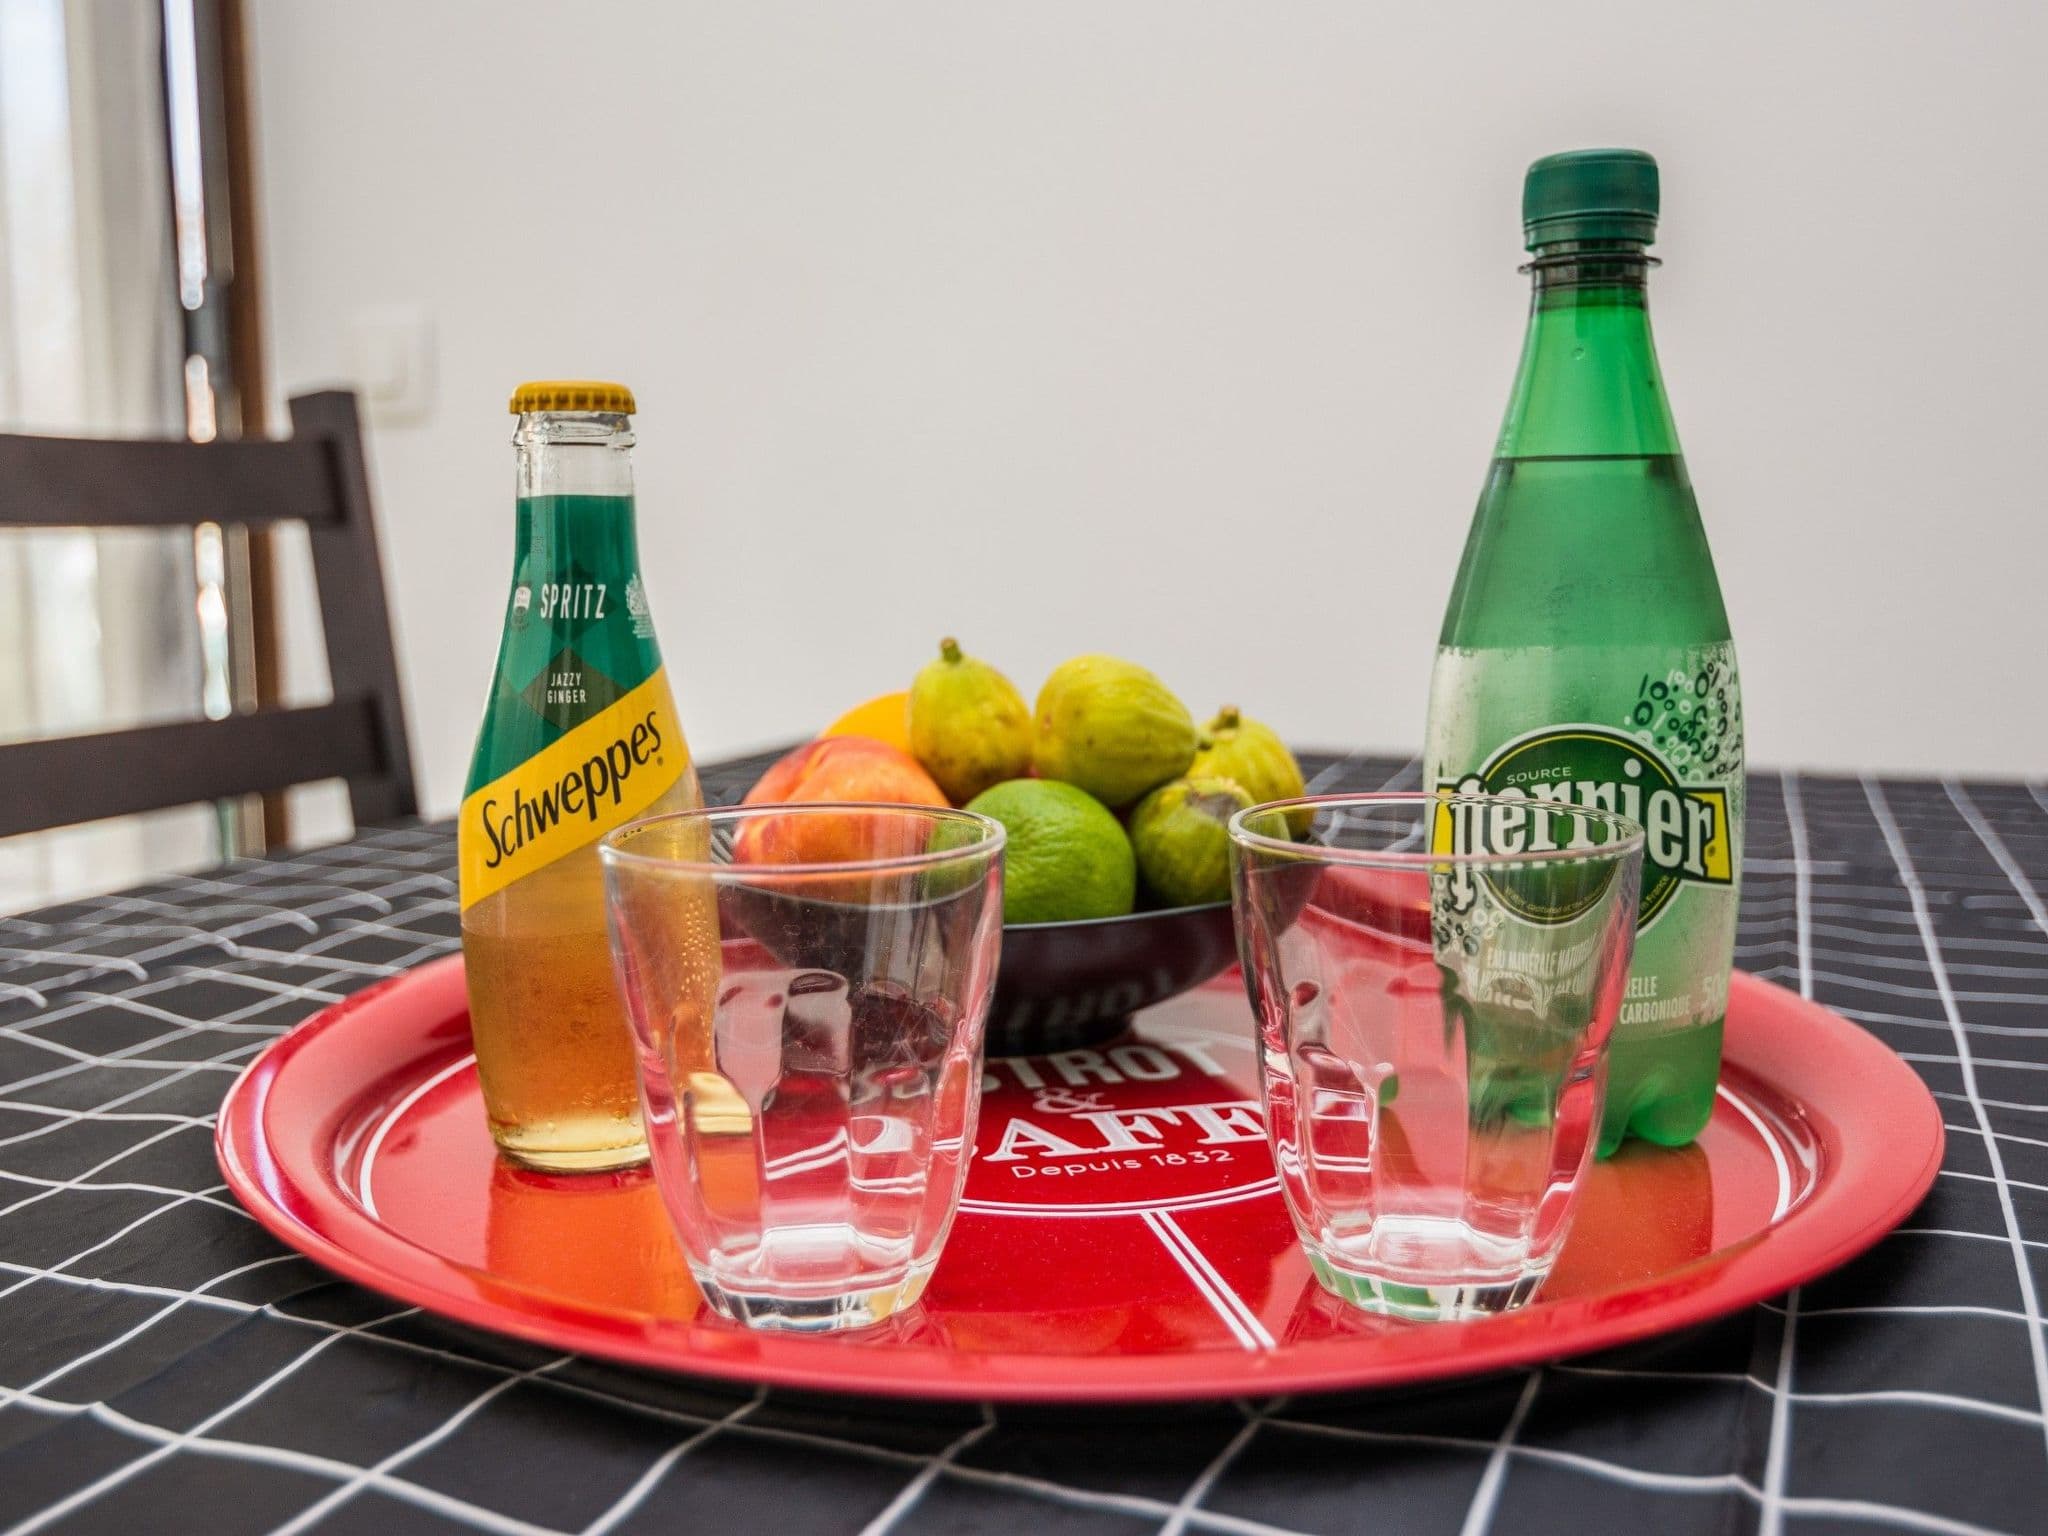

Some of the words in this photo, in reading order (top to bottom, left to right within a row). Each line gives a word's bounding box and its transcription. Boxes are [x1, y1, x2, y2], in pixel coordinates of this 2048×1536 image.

[540, 583, 607, 619] SPRITZ
[551, 672, 582, 687] JAZZY
[547, 689, 587, 704] GINGER
[482, 710, 662, 868] Schweppes
[1506, 766, 1572, 786] SOURCE
[1619, 996, 1691, 1024] CARBONIQUE
[1032, 1087, 1115, 1113] &
[1010, 1158, 1142, 1179] Depuis
[1150, 1149, 1235, 1167] 1832
